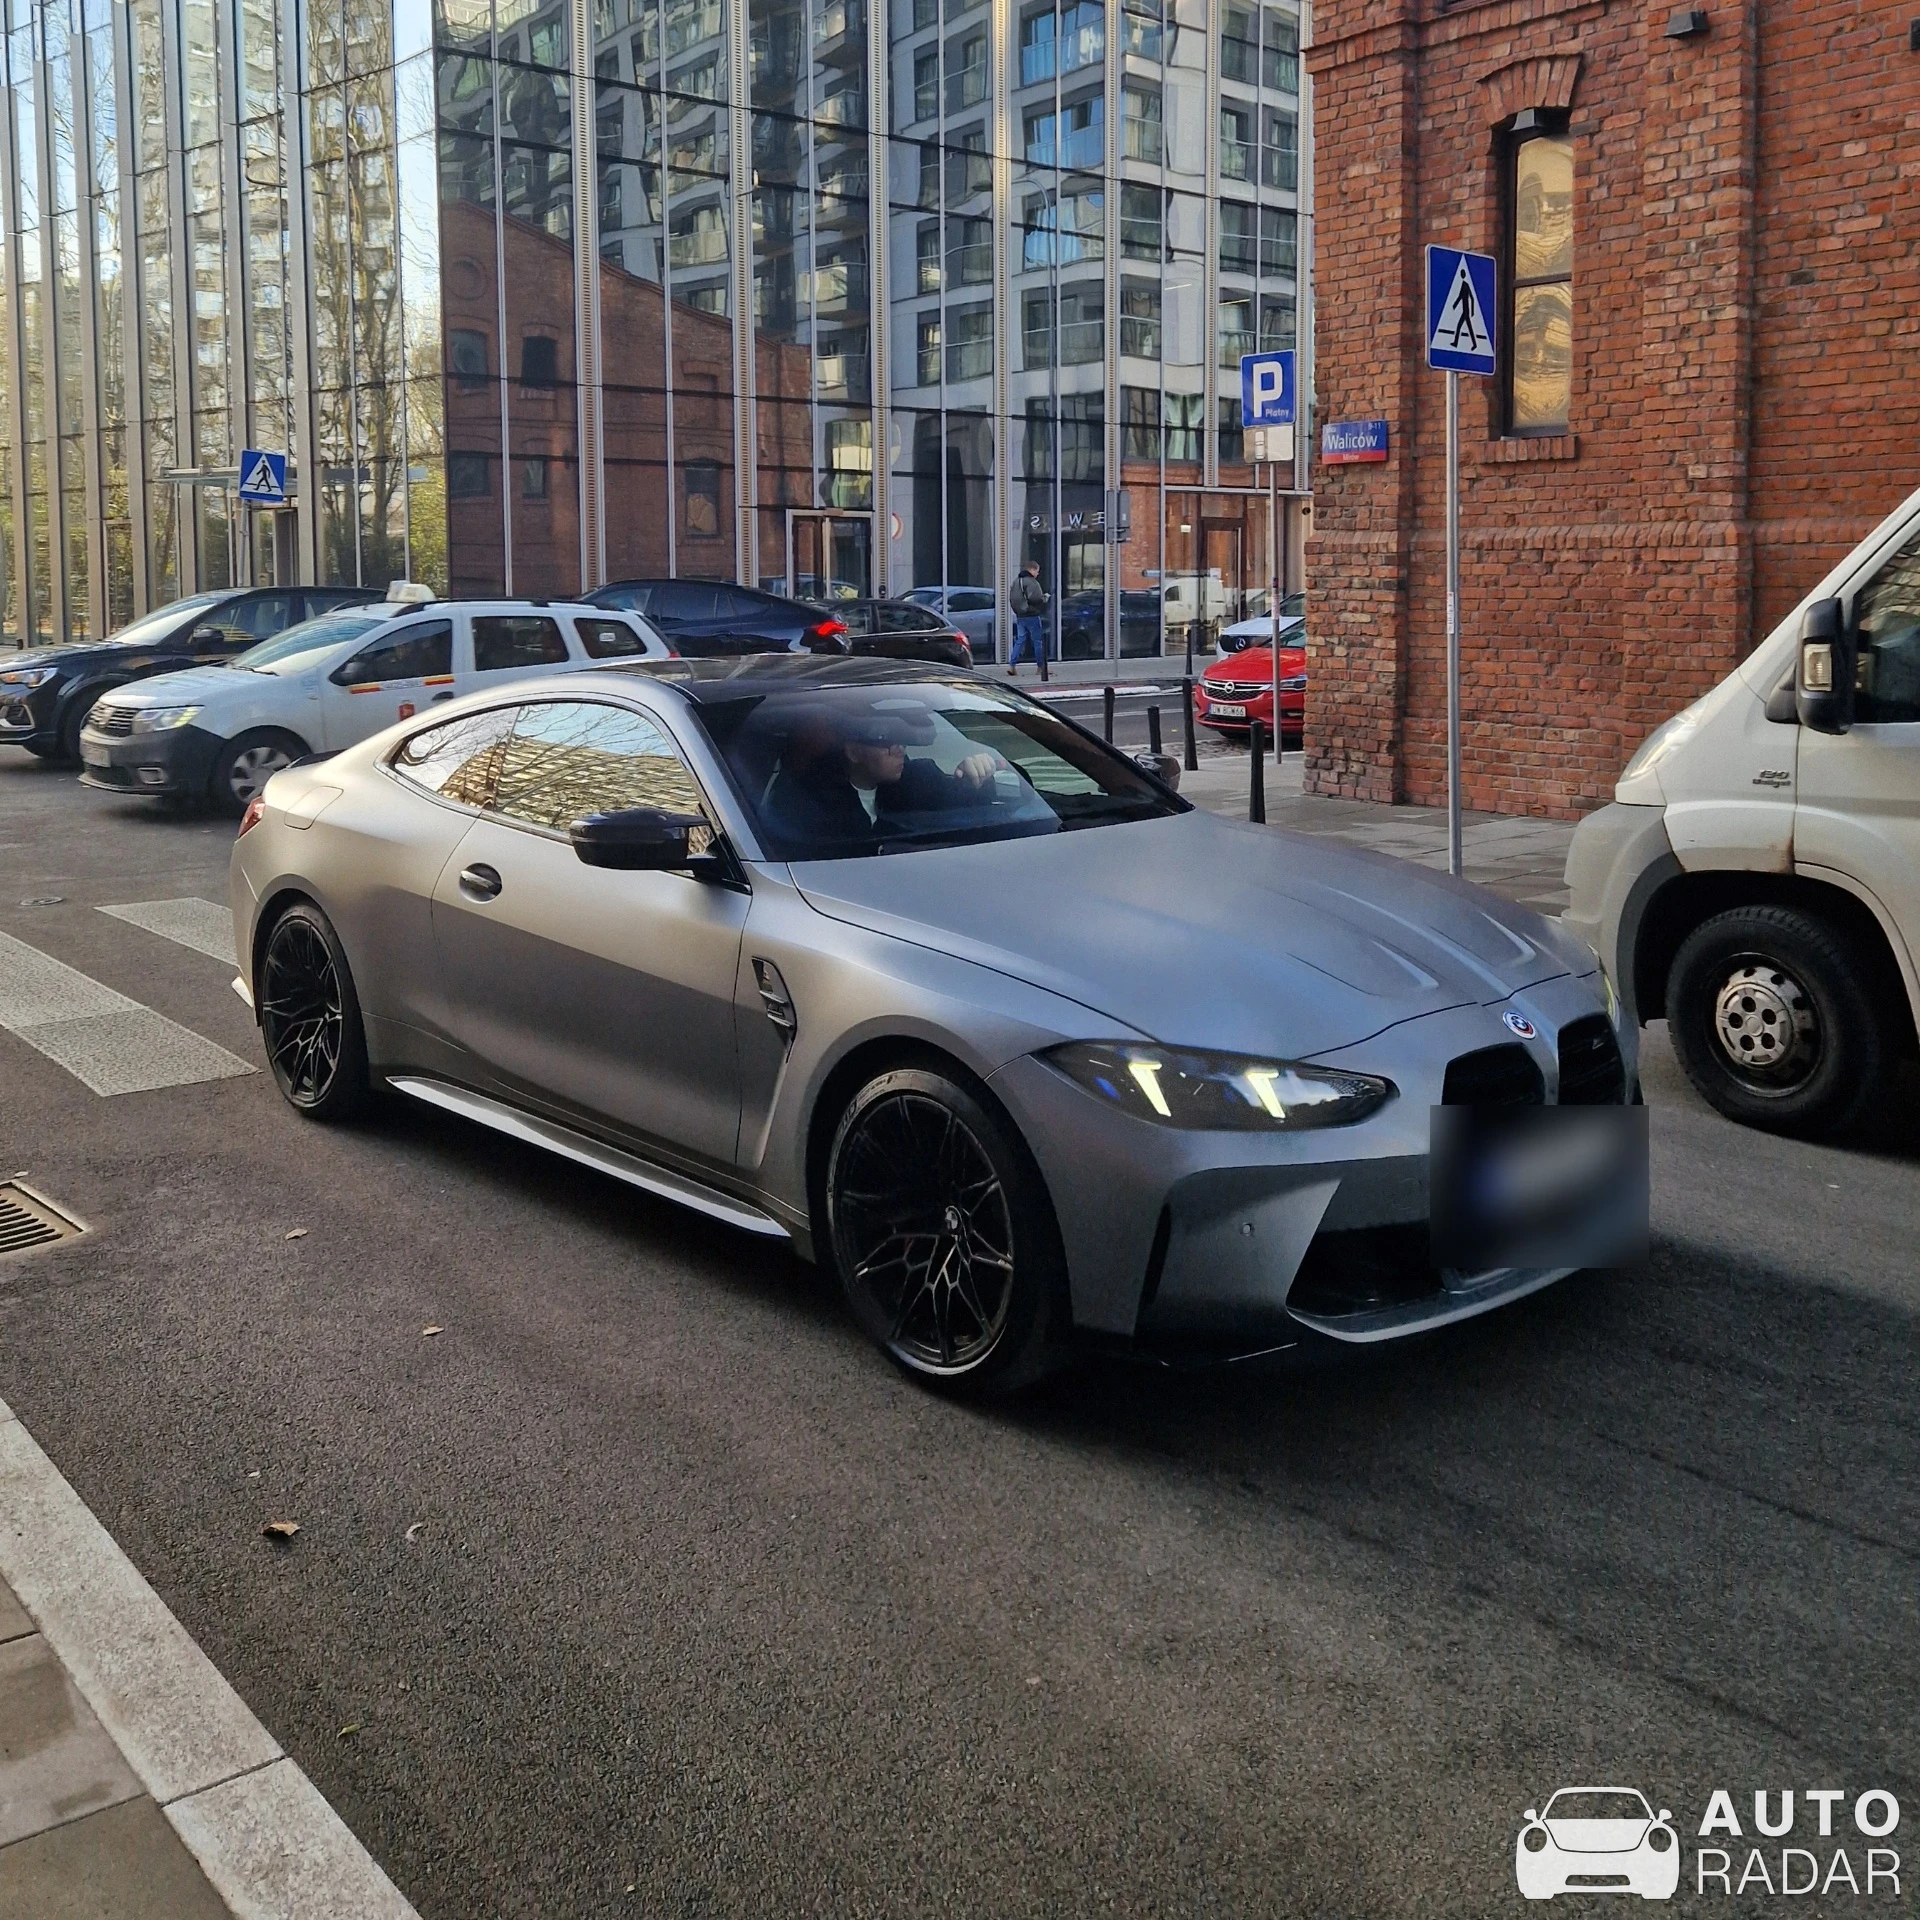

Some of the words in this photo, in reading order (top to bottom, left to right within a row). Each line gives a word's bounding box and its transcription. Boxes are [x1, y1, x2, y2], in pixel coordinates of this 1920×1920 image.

[1253, 361, 1283, 418] P
[1265, 407, 1289, 419] Płatny
[1327, 431, 1378, 450] Waliców
